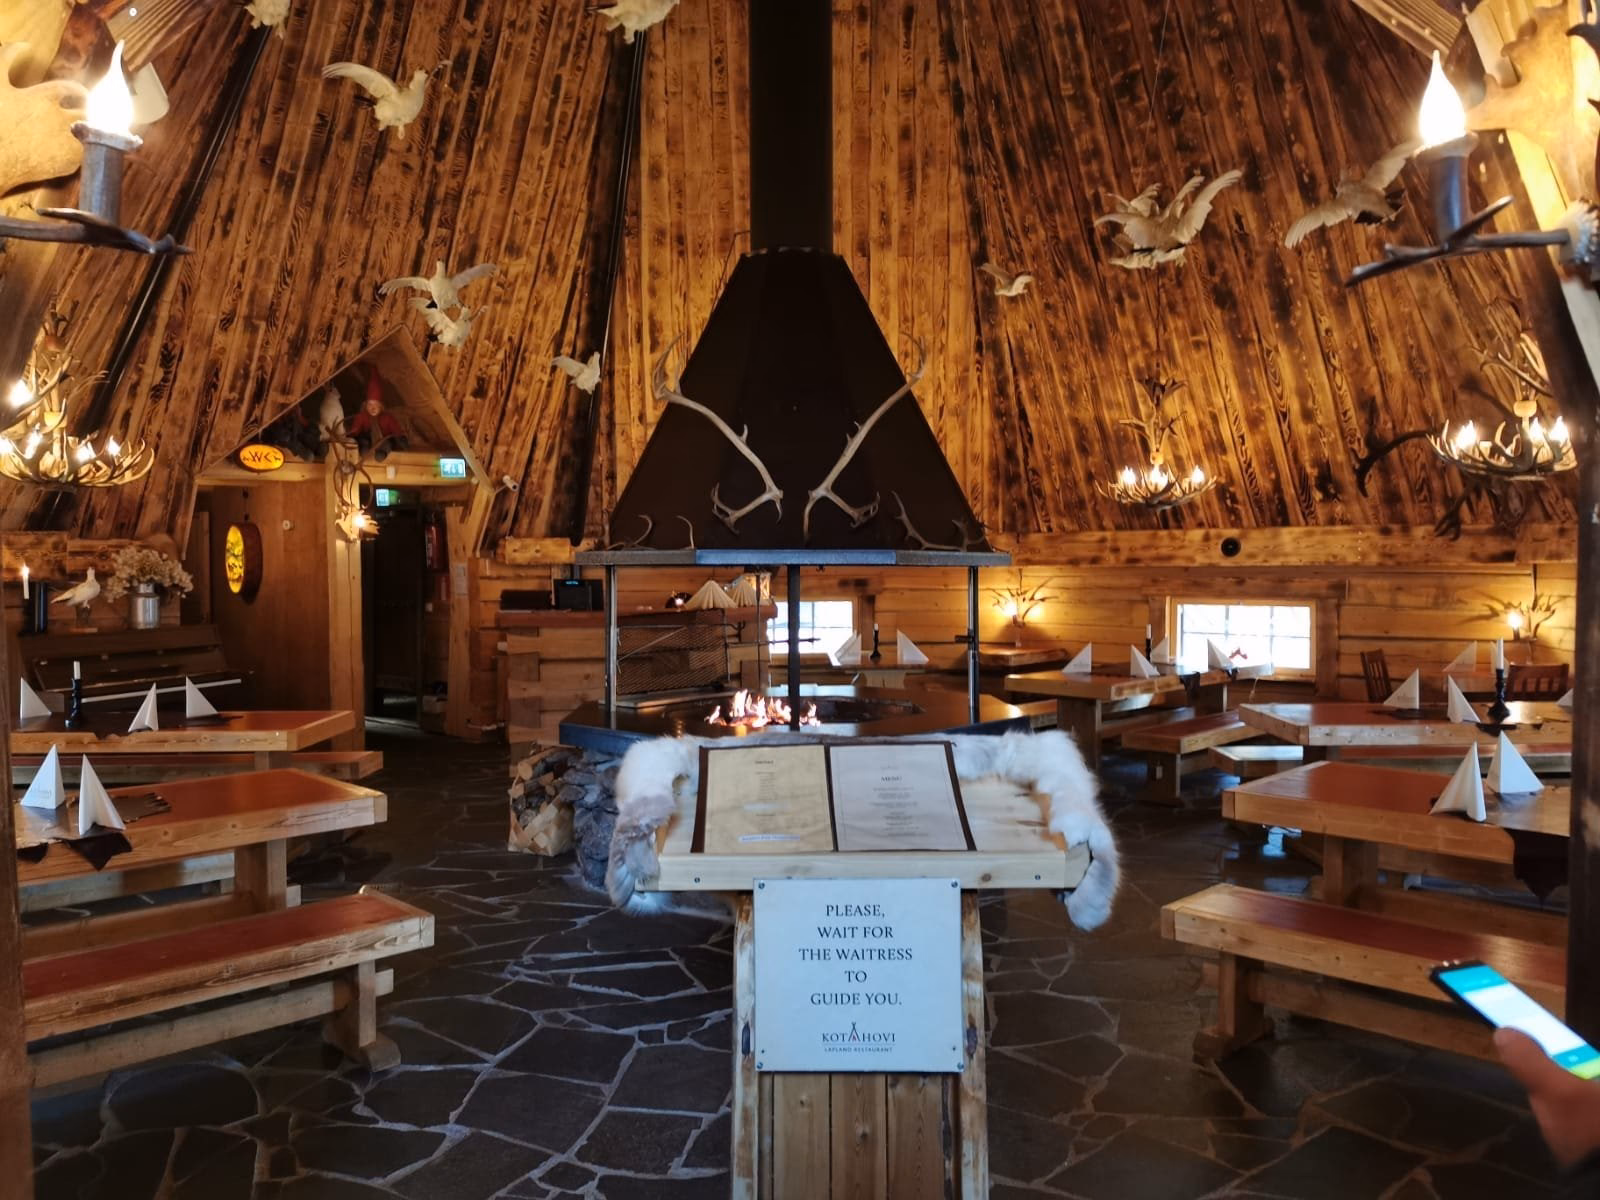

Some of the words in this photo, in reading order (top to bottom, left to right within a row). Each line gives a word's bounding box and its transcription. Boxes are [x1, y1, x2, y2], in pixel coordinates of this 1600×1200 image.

[826, 904, 886, 918] PLEASE,
[817, 926, 858, 939] WAIT
[863, 926, 894, 939] FOR
[799, 948, 832, 961] THE
[836, 948, 913, 961] WAITRESS
[844, 970, 868, 983] TO
[810, 992, 861, 1006] GUIDE
[865, 992, 902, 1006] YOU.
